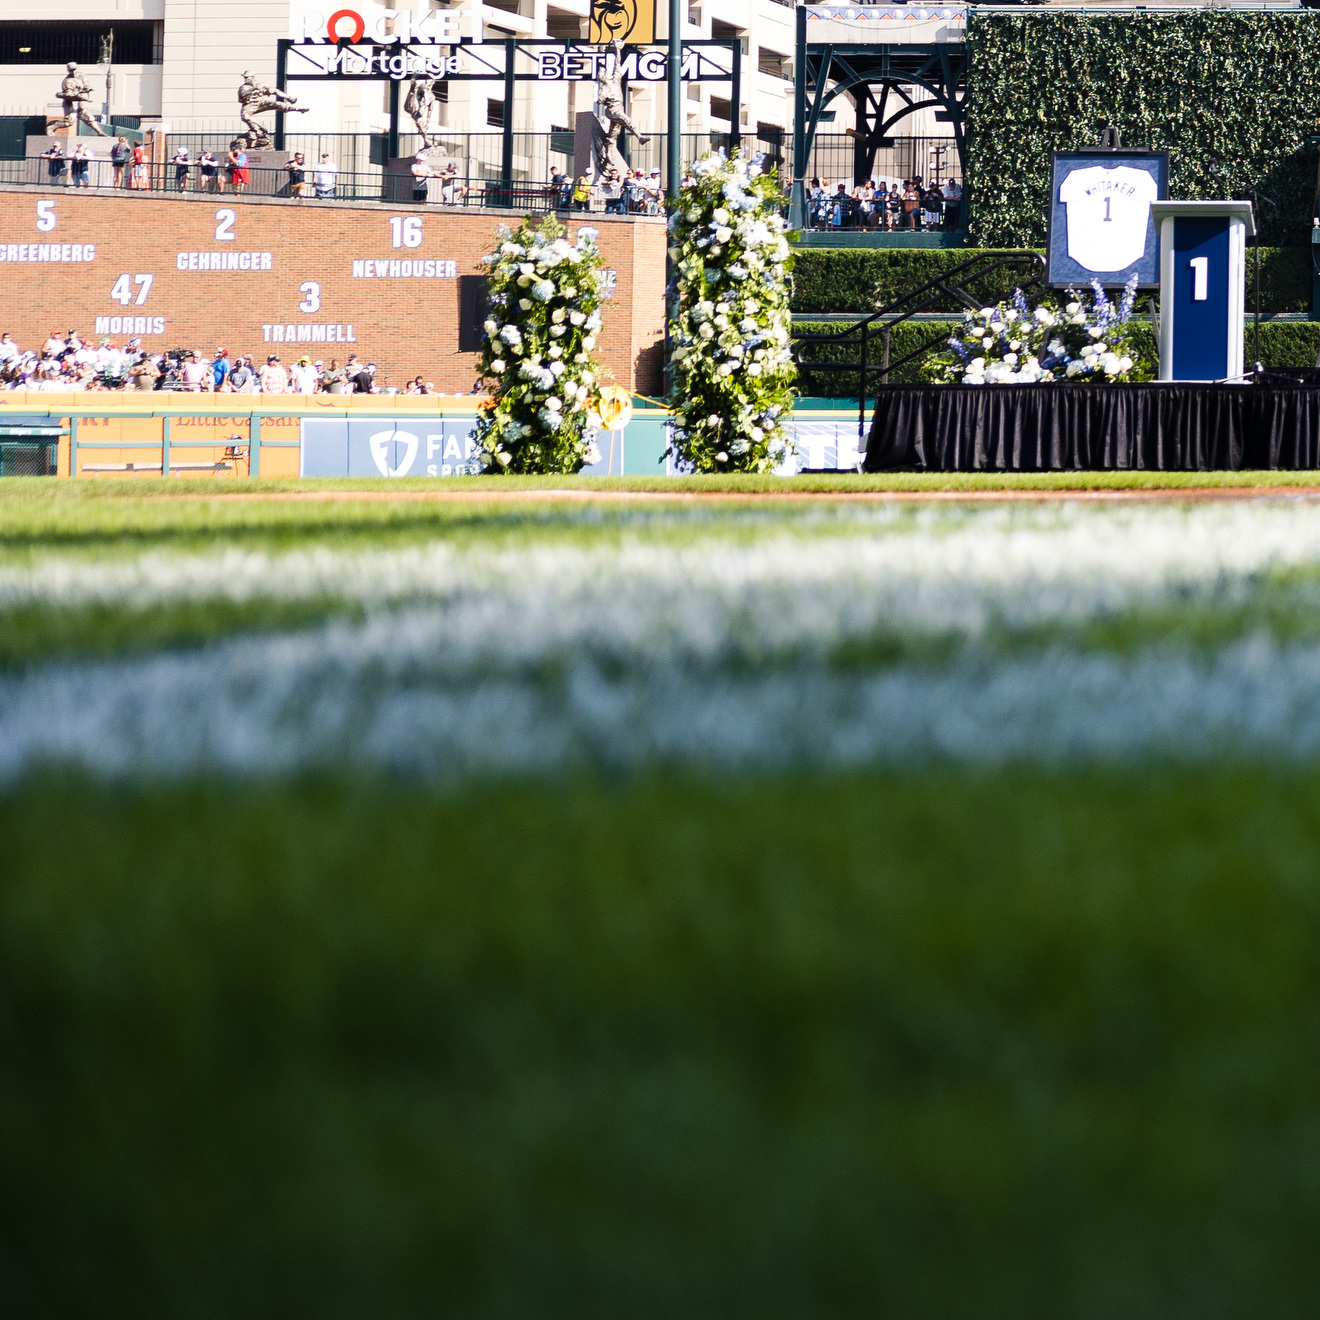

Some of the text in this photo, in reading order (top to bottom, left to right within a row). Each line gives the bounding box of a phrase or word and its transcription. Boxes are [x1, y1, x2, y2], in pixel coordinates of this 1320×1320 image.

[294, 9, 494, 44] ROCKET
[325, 48, 464, 79] Mortgage
[36, 199, 57, 232] 5
[215, 208, 236, 241] 2
[1103, 196, 1112, 222] 1
[389, 216, 423, 248] 16
[0, 244, 95, 262] GREENBERG
[176, 252, 272, 270] GEHRINGER
[353, 259, 457, 277] NEWHOUSER
[110, 273, 154, 305] 47
[1190, 257, 1208, 301] 1
[299, 281, 321, 313] 3
[95, 316, 166, 335] MORRIS
[262, 324, 357, 342] TRAMMELL
